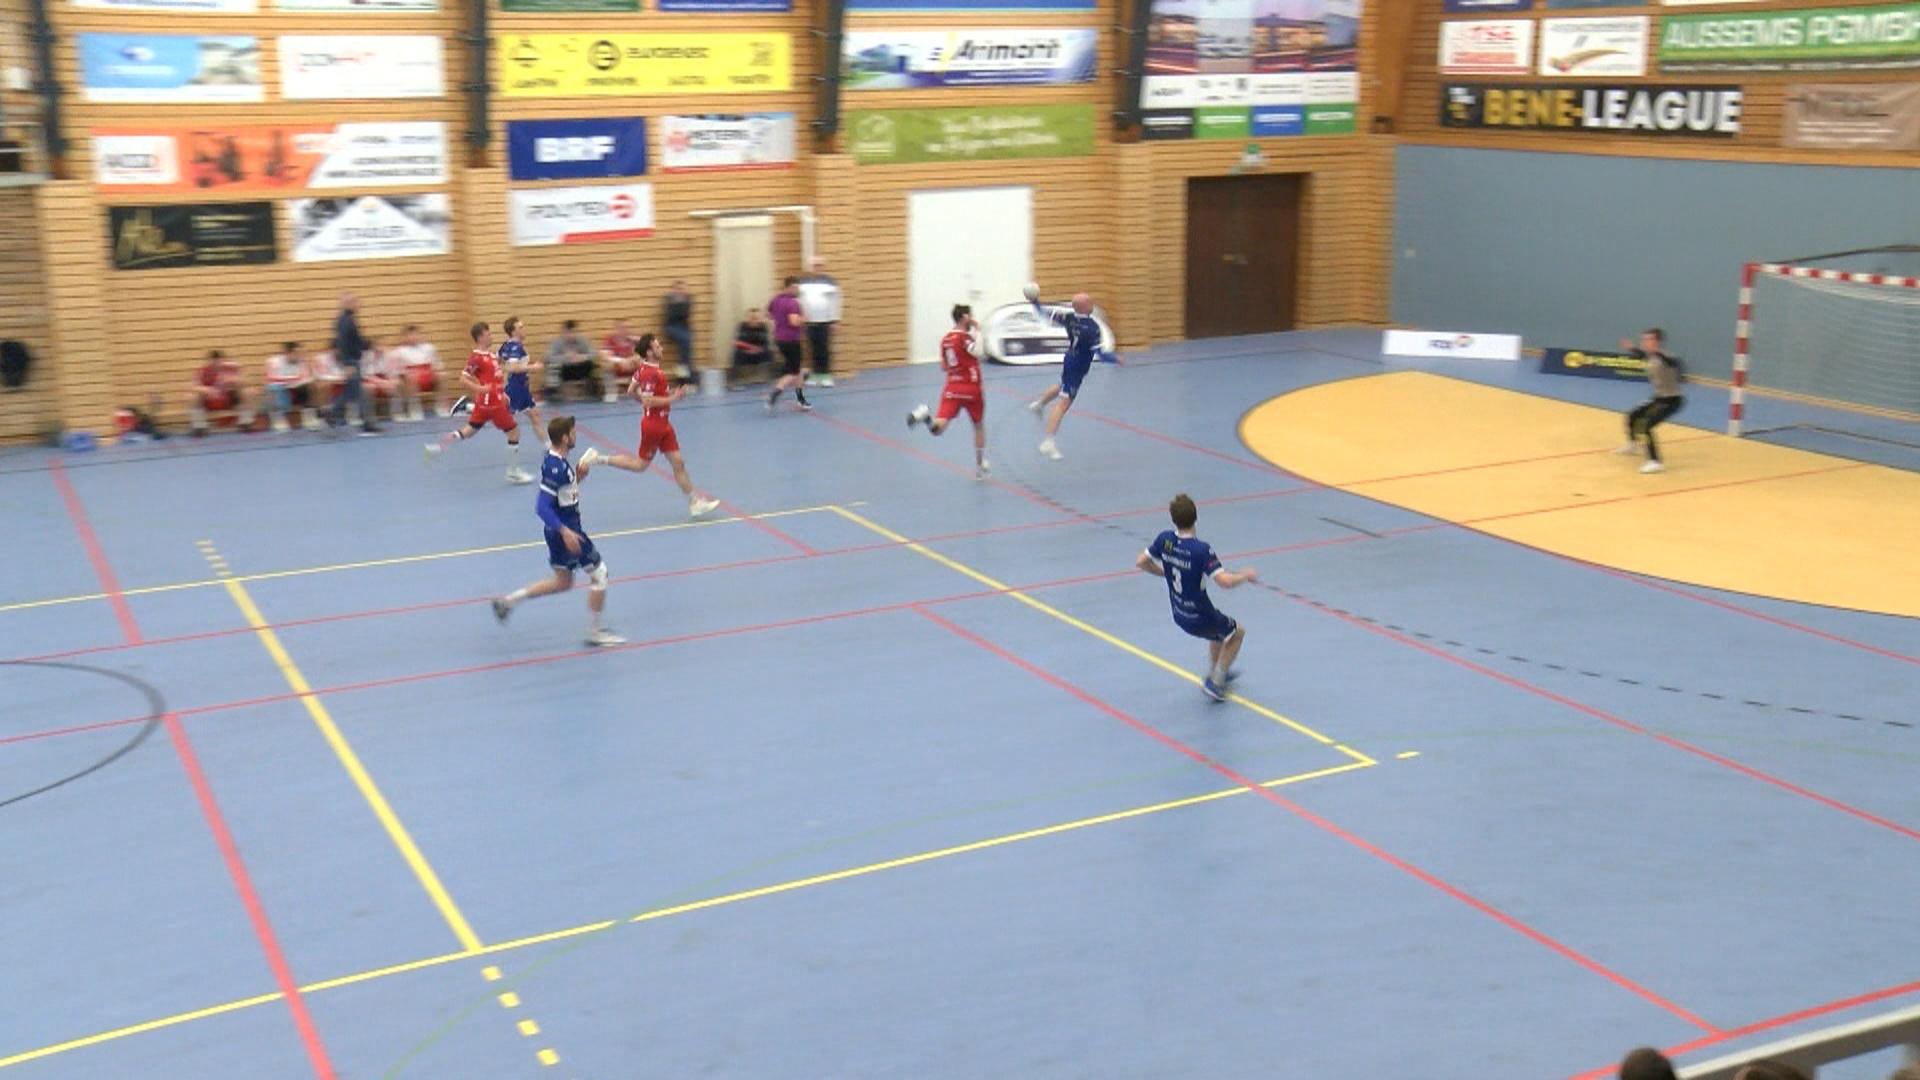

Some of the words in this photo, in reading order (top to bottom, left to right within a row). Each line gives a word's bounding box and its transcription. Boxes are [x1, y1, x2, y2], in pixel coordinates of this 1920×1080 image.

[1665, 18, 1804, 48] AUSSEMS
[1482, 88, 1744, 133] BENE-LEAGUE
[534, 136, 616, 163] BRF
[1171, 566, 1183, 595] 3
